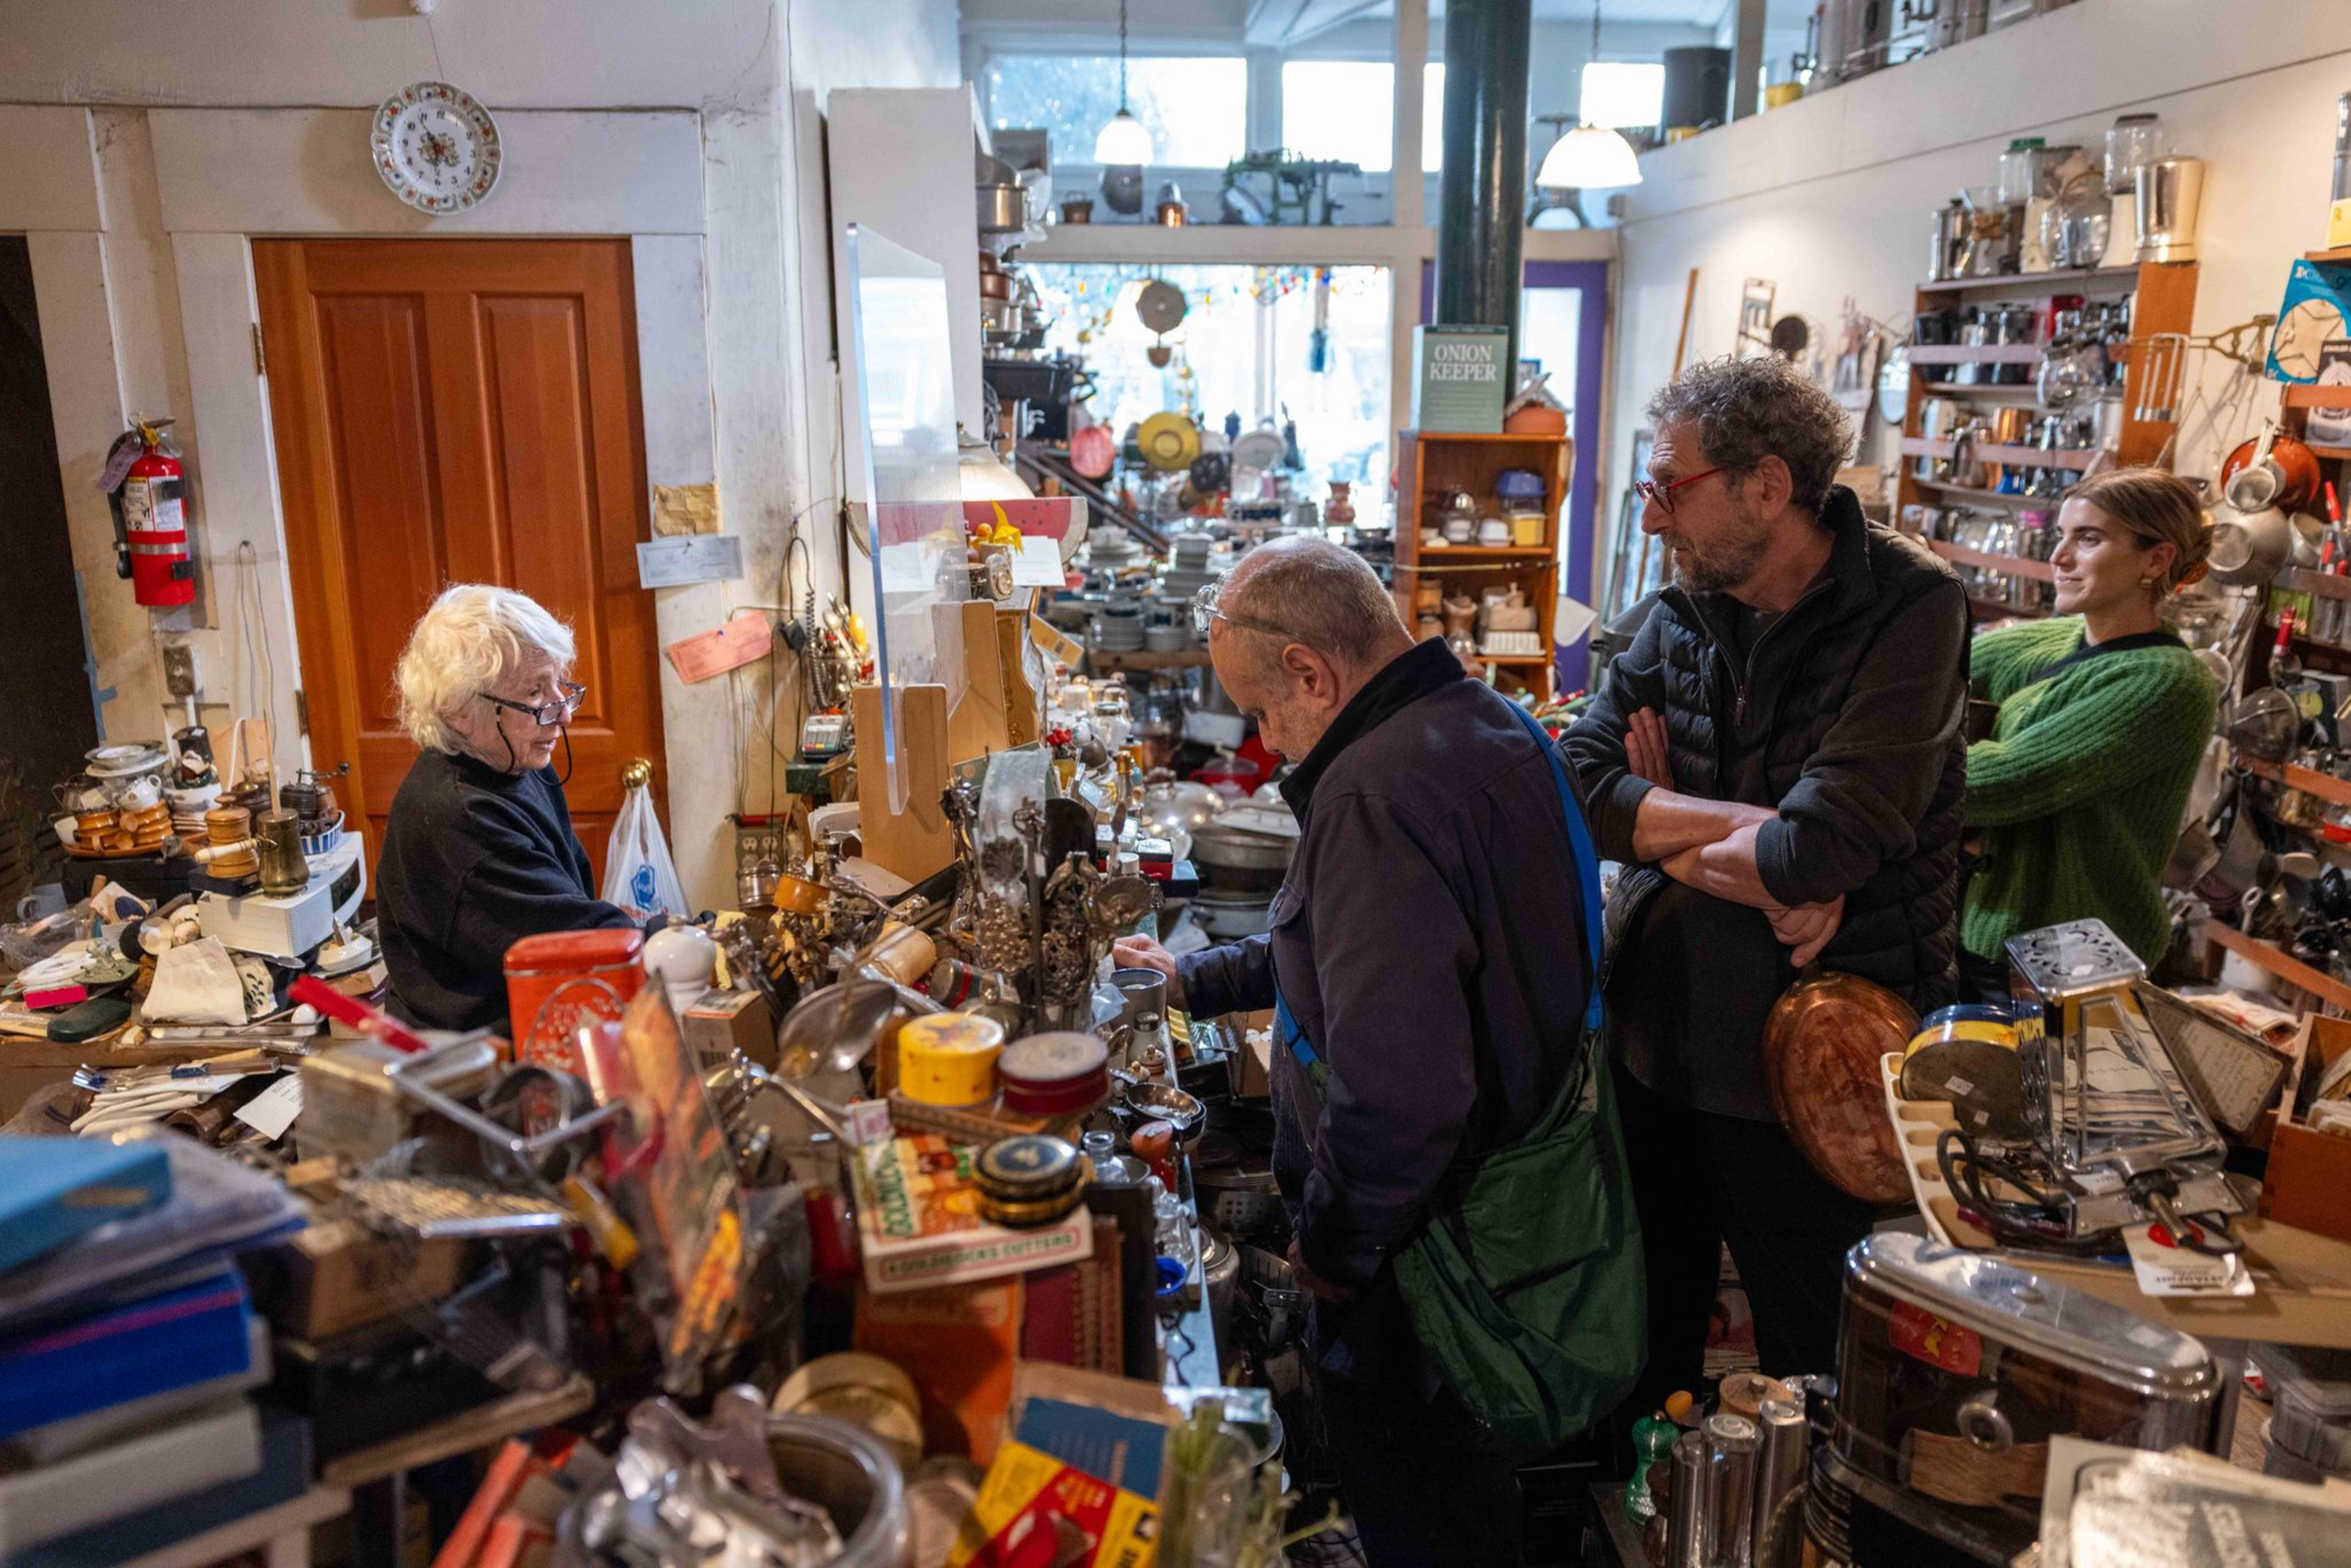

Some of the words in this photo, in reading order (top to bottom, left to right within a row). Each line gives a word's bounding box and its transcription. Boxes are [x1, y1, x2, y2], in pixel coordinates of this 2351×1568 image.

[437, 110, 445, 119] 12
[407, 156, 413, 165] 8
[464, 166, 470, 175] 4
[451, 176, 457, 184] 5
[1434, 343, 1493, 362] ONION
[1429, 362, 1497, 381] KEEPER
[1002, 1234, 1073, 1255] CUTTERS
